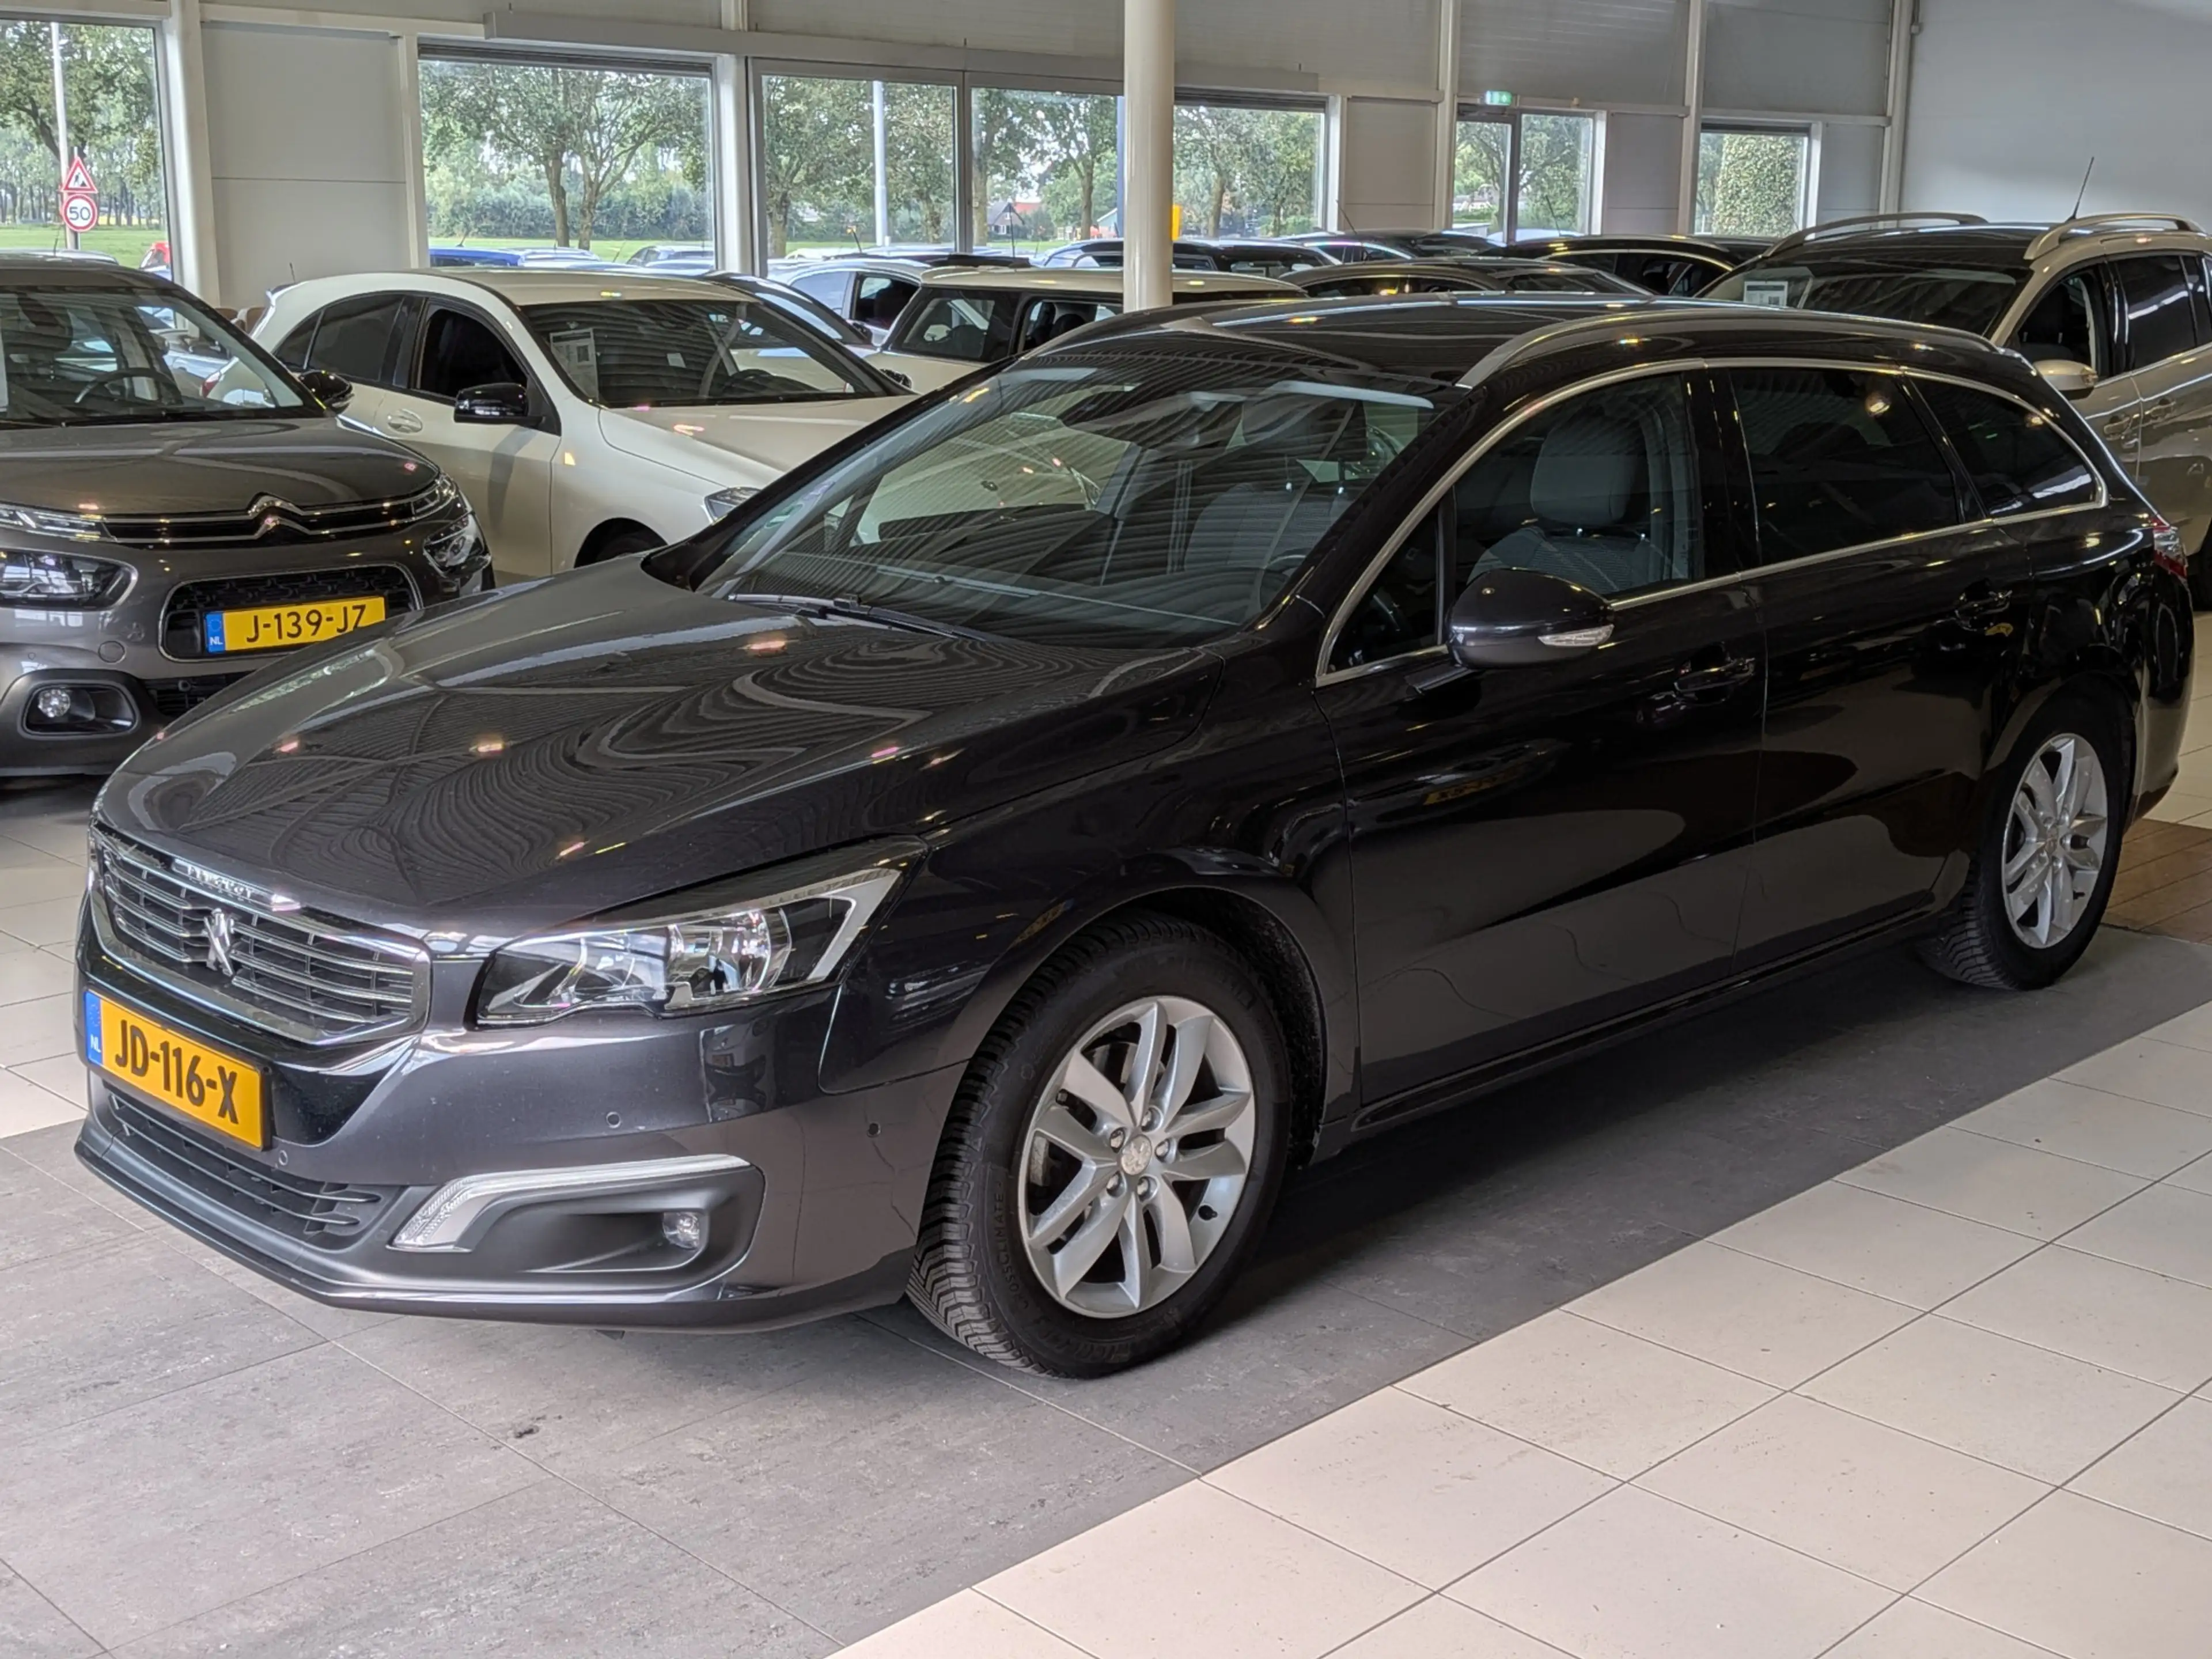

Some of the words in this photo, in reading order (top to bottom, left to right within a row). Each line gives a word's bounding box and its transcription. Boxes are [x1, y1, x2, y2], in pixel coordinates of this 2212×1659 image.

[69, 206, 90, 221] 50
[210, 637, 224, 646] NL
[90, 1034, 102, 1053] NL
[115, 1019, 239, 1124] JD-116-X
